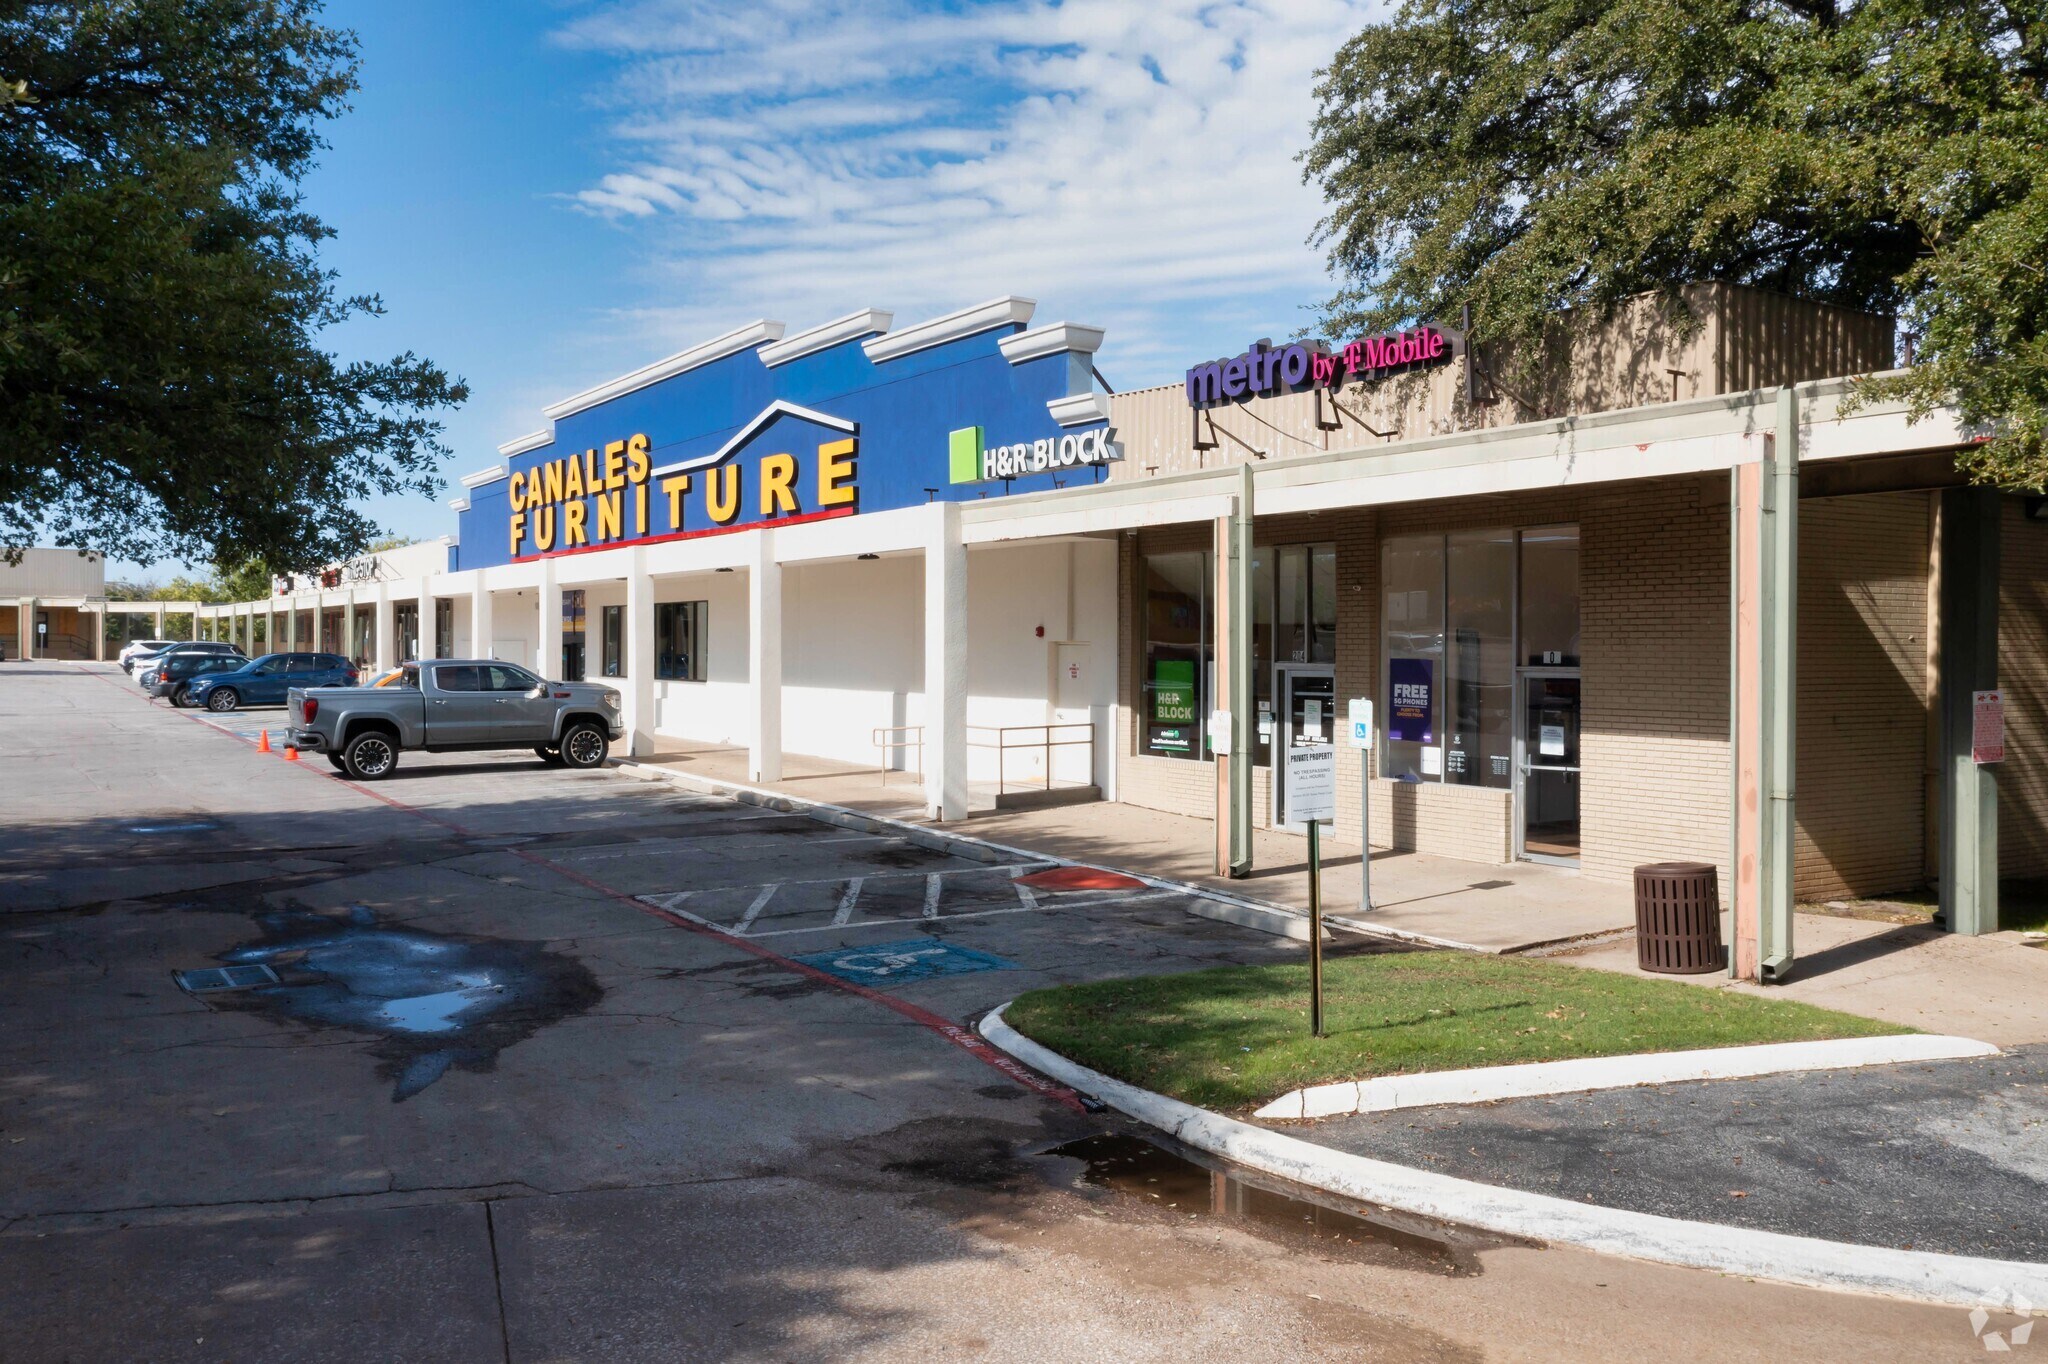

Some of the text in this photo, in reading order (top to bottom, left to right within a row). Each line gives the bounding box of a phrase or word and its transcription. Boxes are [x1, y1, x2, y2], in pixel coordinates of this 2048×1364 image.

[1186, 344, 1307, 402] metro
[1312, 352, 1338, 387] by
[983, 427, 1112, 480] H&R BLOCK
[509, 433, 651, 514] CANALES
[510, 438, 857, 555] FURNITURE
[1394, 683, 1429, 699] FREE
[1157, 692, 1179, 705] H&R
[1402, 698, 1428, 706] PHONES
[1157, 706, 1192, 719] BLOCK
[1290, 752, 1333, 764] PRIVATE PROPERTY
[1301, 767, 1331, 775] TRESPASSING
